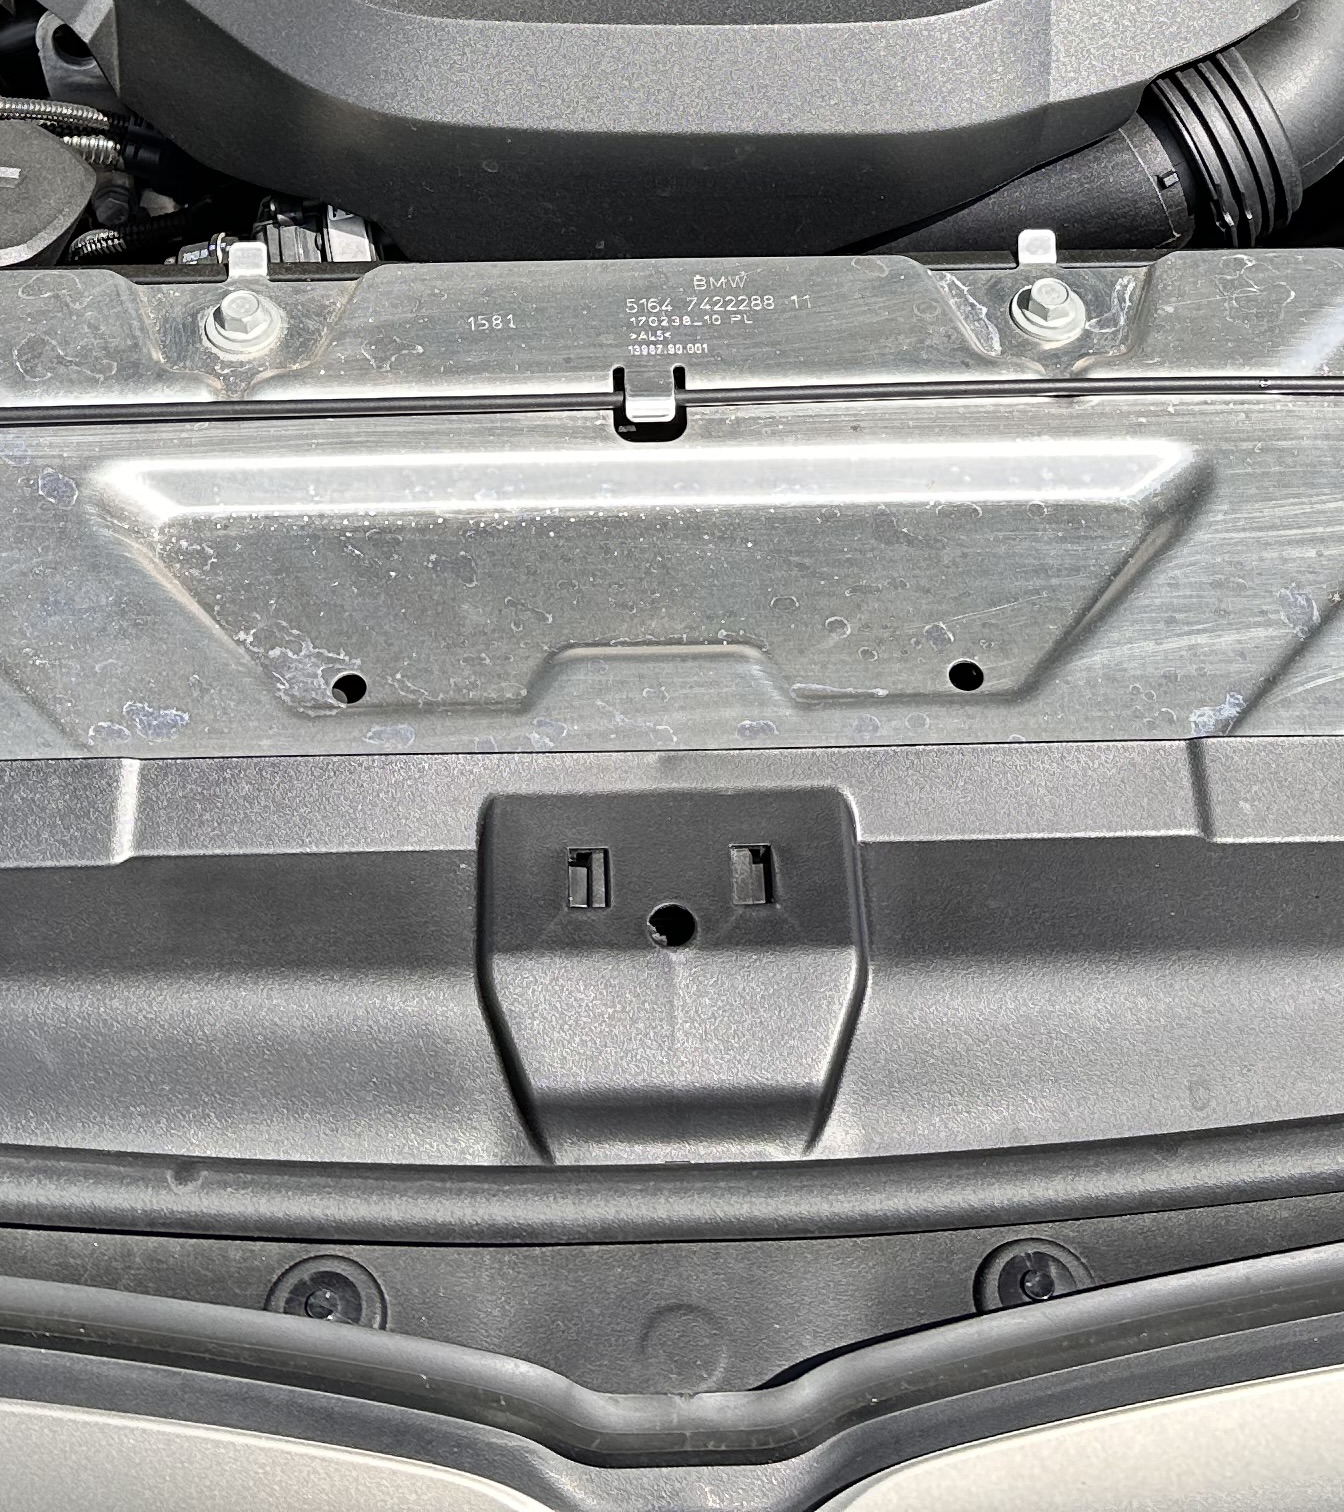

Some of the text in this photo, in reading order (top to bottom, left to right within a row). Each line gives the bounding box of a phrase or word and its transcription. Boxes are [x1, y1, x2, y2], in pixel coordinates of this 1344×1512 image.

[693, 274, 748, 290] BMW
[625, 294, 812, 313] 5164 7422288 11
[467, 313, 516, 331] 1581
[730, 314, 753, 325] PL
